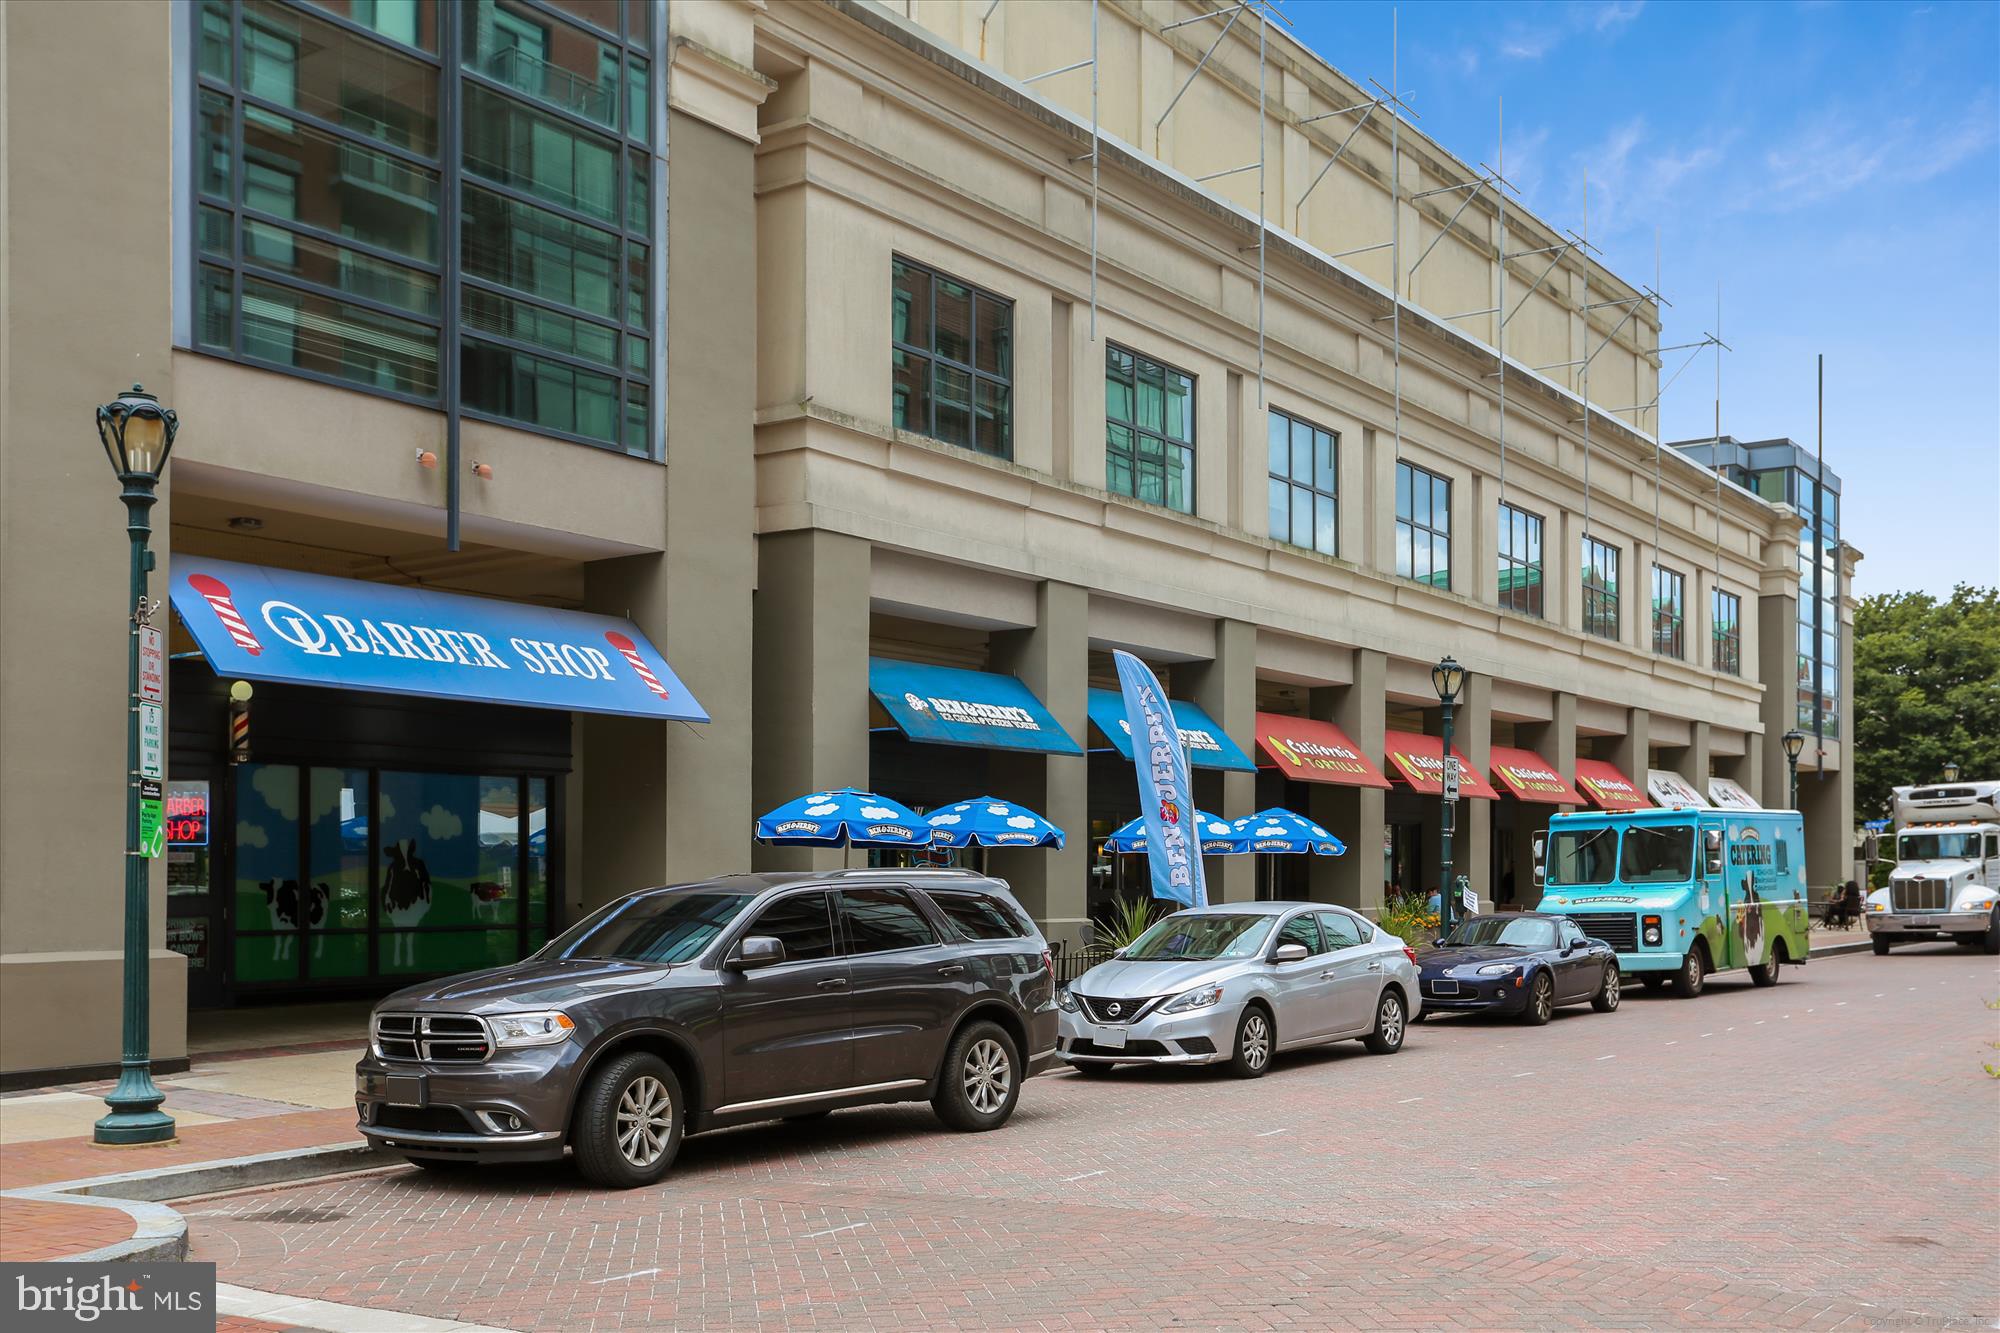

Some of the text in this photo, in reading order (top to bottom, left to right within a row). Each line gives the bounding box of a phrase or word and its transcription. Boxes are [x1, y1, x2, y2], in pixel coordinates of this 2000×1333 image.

[323, 613, 511, 670] BARBER
[510, 637, 615, 681] SHOP
[1286, 738, 1357, 760] California
[1304, 757, 1367, 774] TORTILLA
[1446, 760, 1457, 771] ONE
[1446, 773, 1457, 781] WAY
[167, 796, 206, 816] ARBER
[1162, 826, 1190, 888] BEN
[1730, 845, 1771, 866] CATERING
